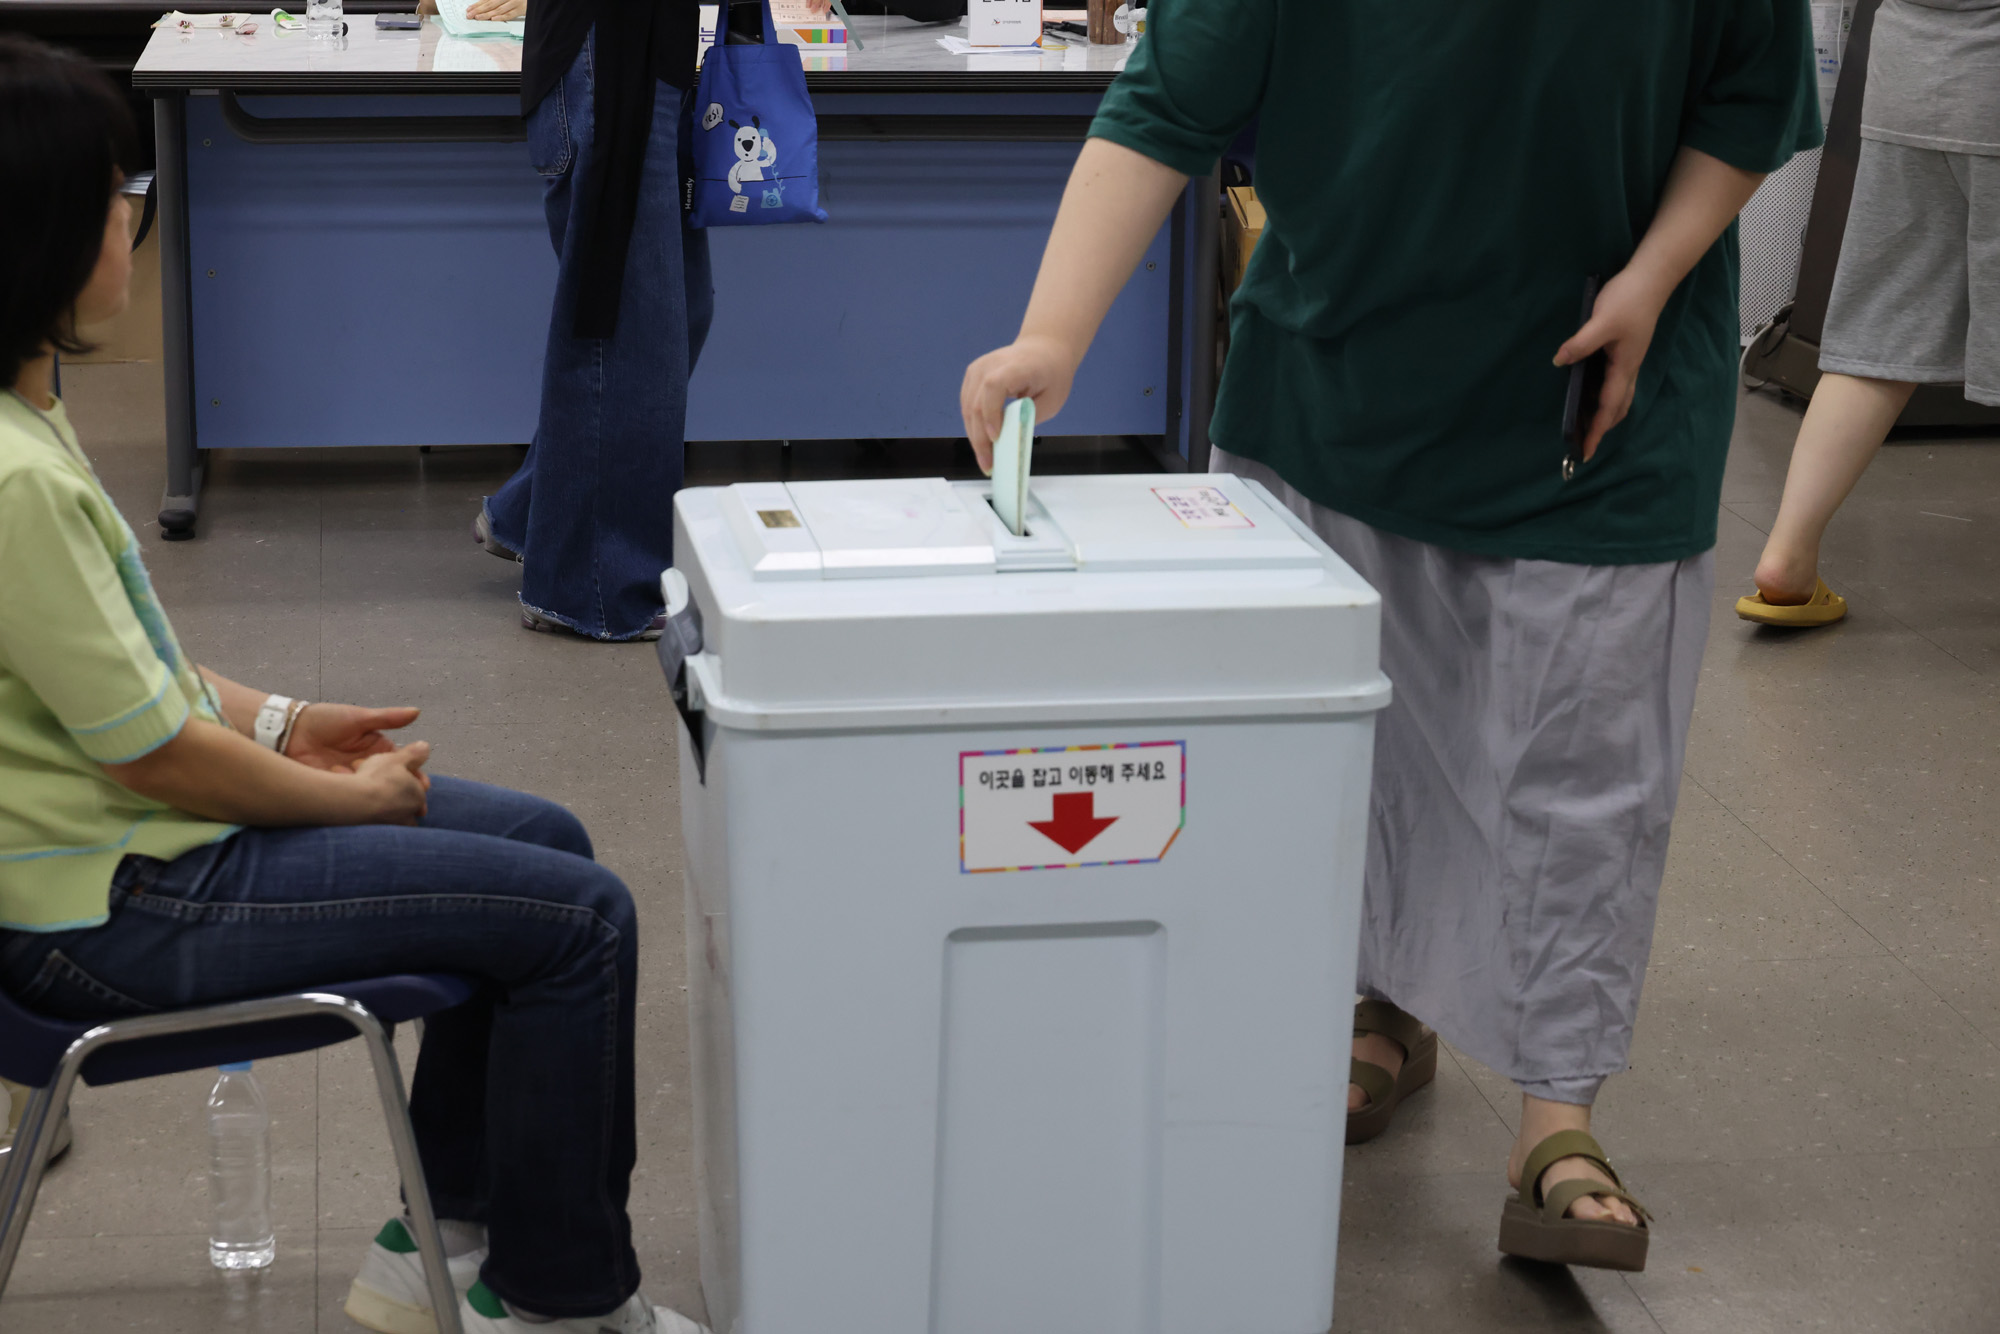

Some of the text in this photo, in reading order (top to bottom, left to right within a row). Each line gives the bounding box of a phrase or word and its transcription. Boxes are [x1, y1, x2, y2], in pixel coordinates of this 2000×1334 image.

[979, 760, 1167, 790] 이곳을 잡고 이동해 주세요
